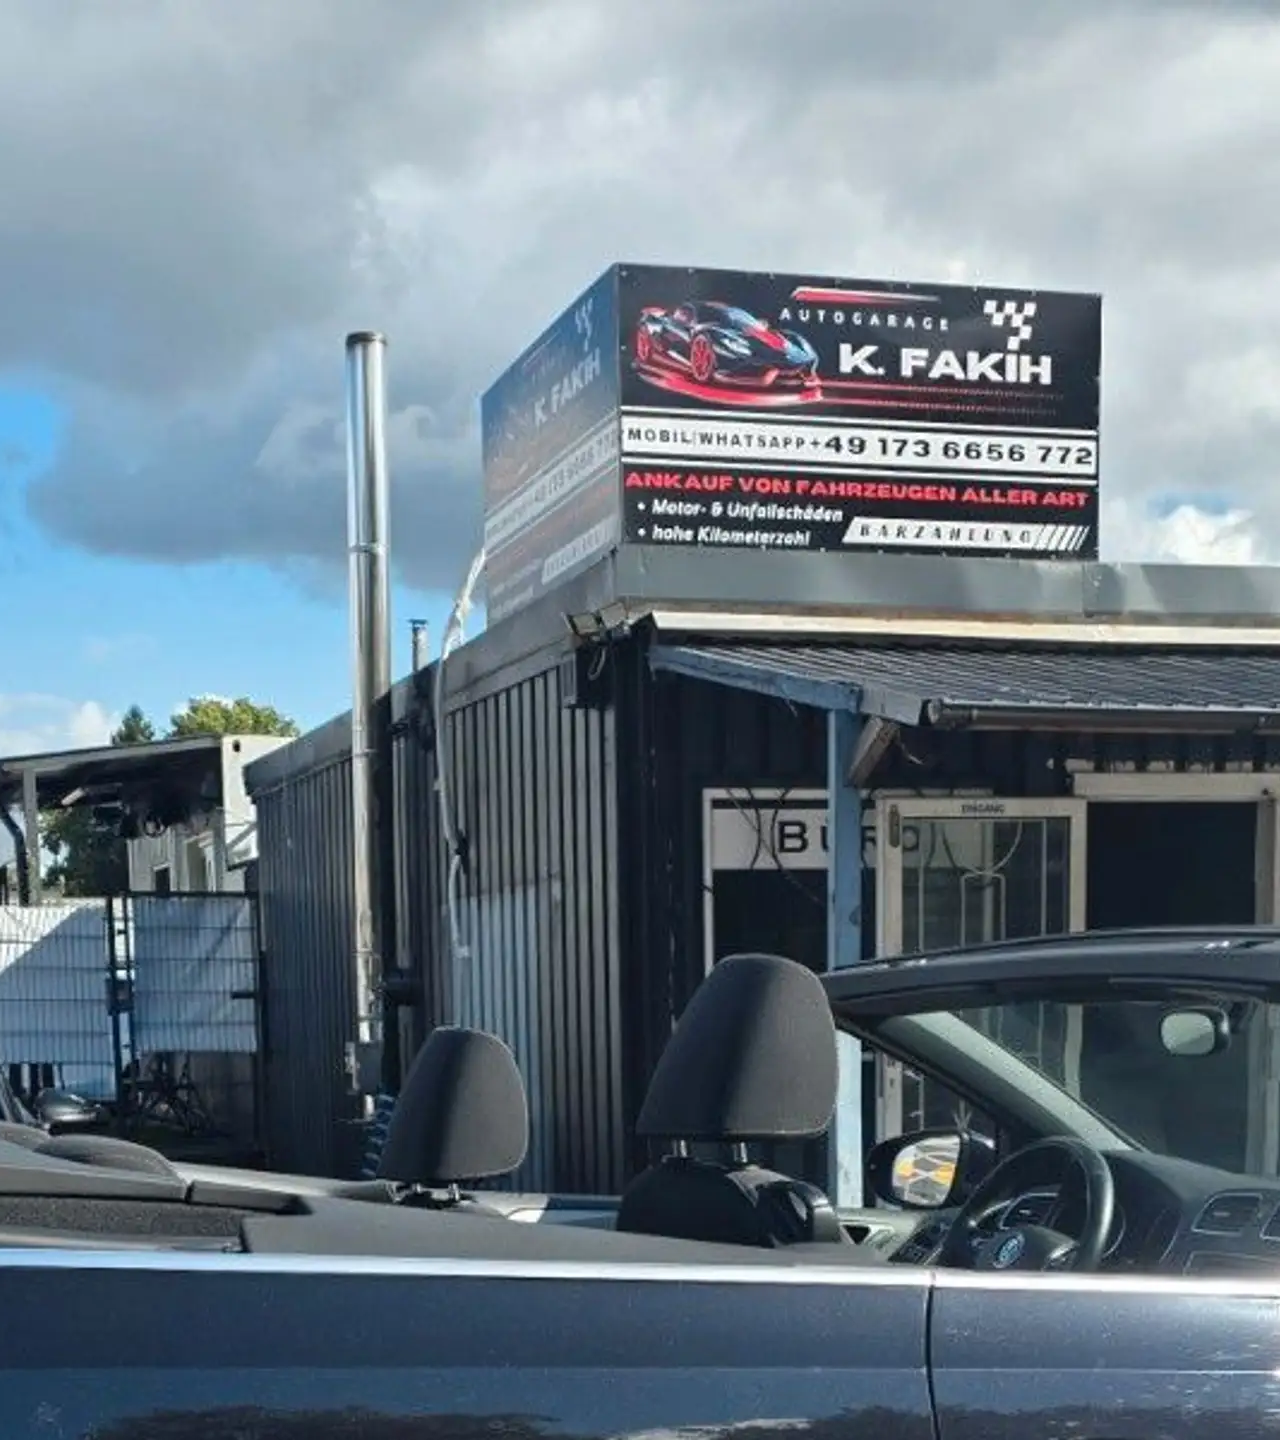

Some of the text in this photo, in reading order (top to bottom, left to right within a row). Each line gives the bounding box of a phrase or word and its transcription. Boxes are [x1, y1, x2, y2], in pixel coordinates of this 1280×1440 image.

[780, 307, 949, 332] AUTOGARAGE
[838, 343, 885, 376] K.
[810, 436, 867, 455] +49
[878, 439, 932, 458] 173
[942, 441, 1026, 463] 6656
[1037, 445, 1093, 466] 772
[625, 471, 1090, 509] ANKAUF VON FAHRZEUGEN ALLER ART
[651, 498, 844, 524] Motor- & Unfallschäden
[651, 525, 811, 547] hohe Kilometerzahl
[859, 523, 1031, 545] BARZAHLUNG
